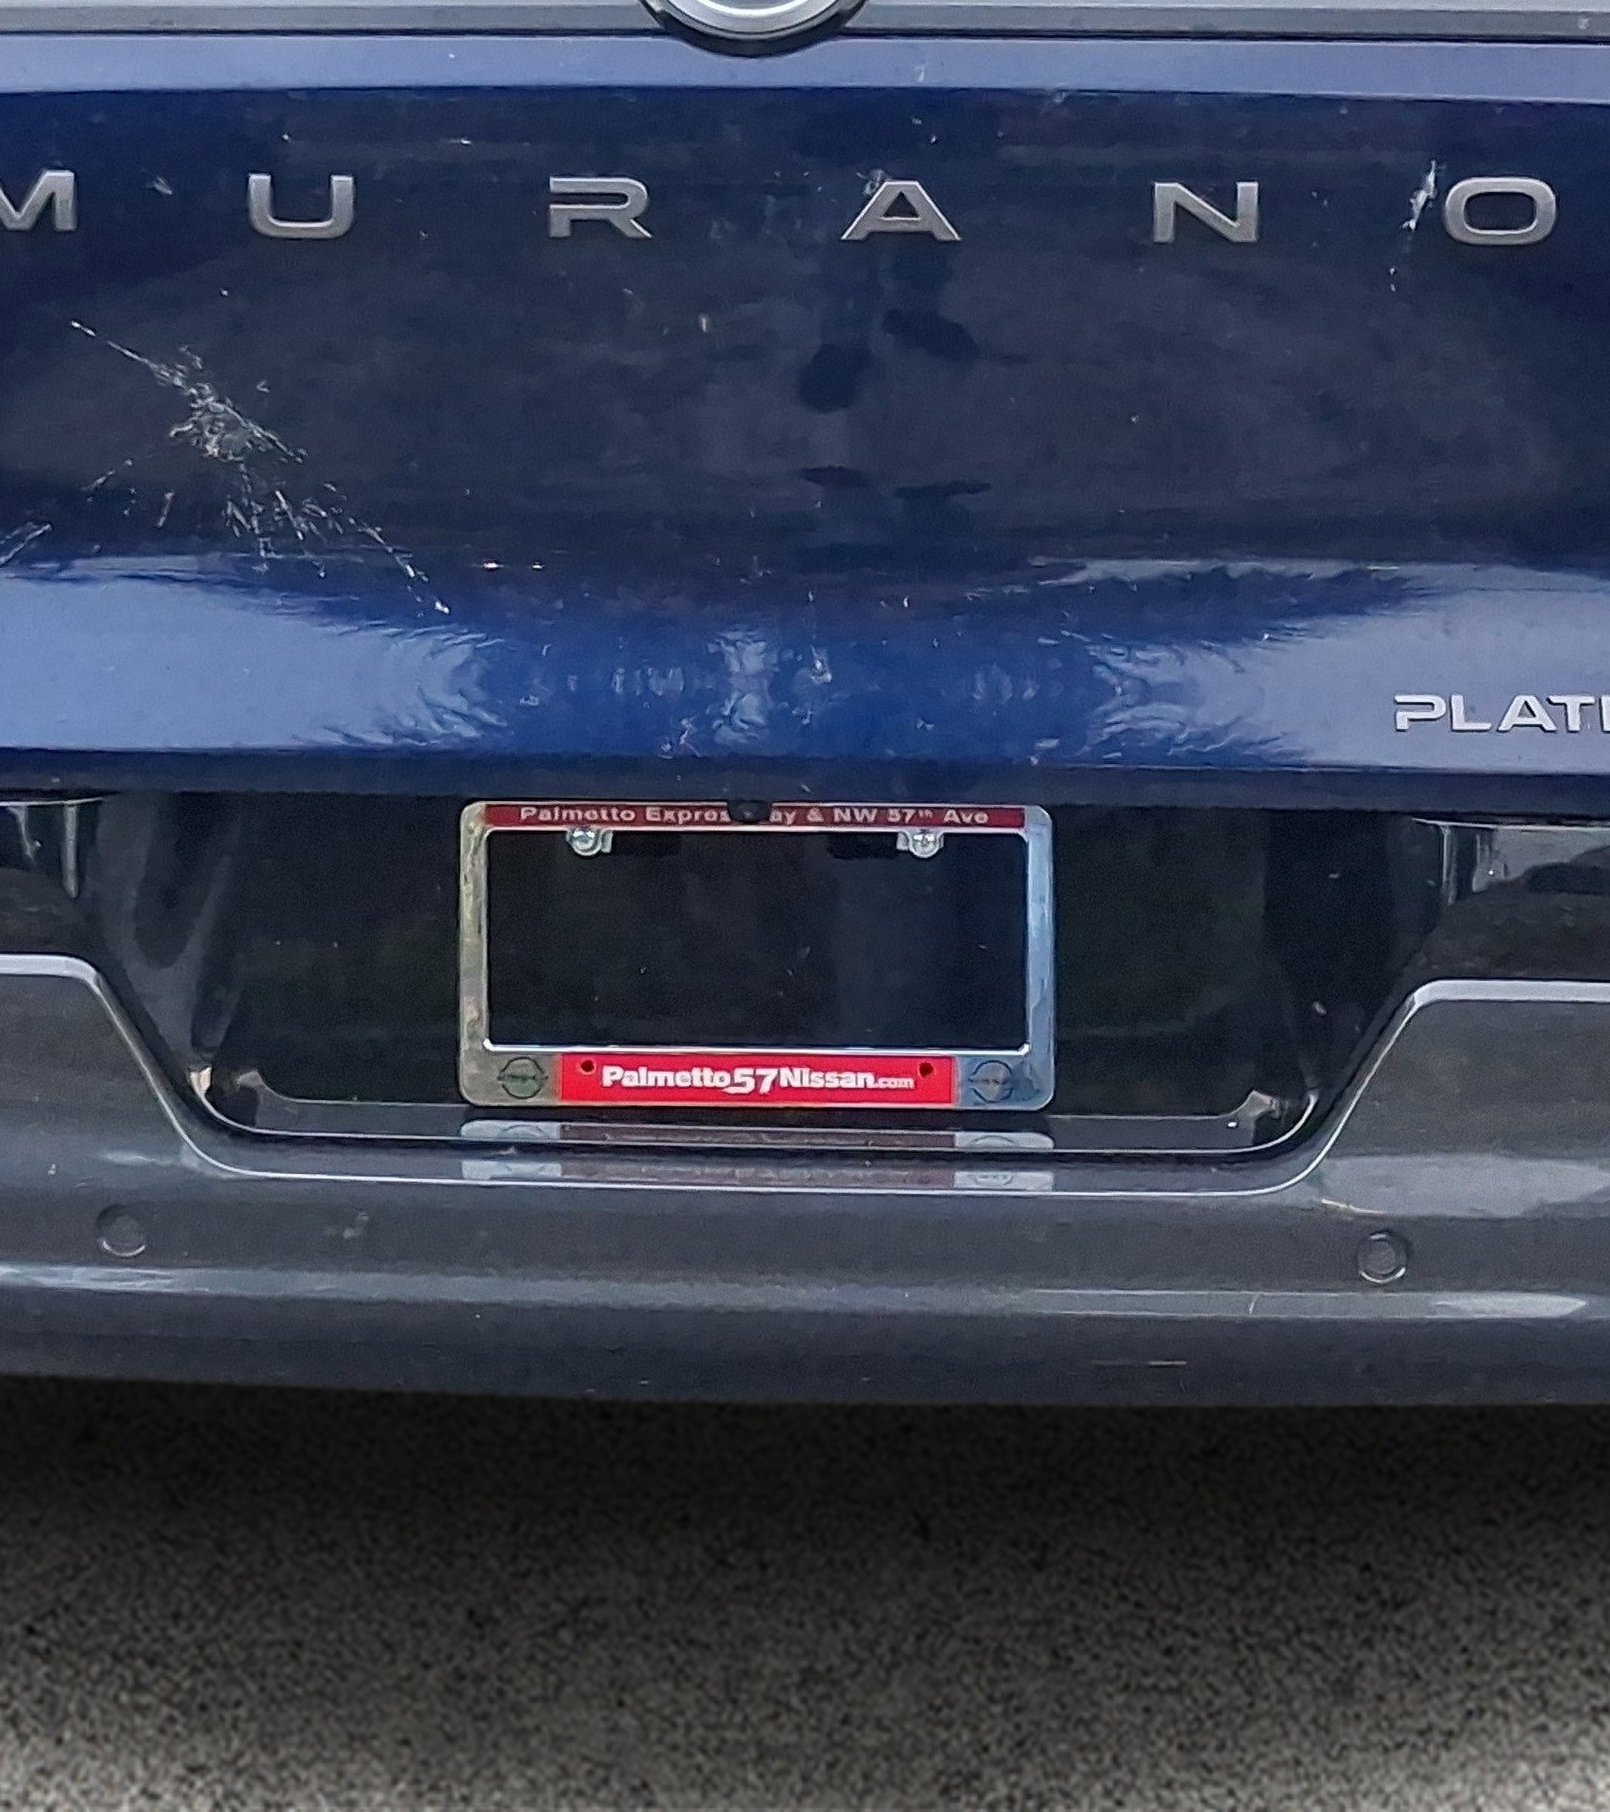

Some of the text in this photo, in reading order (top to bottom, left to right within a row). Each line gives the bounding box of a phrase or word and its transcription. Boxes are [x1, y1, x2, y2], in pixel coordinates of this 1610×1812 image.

[520, 806, 636, 822] Palmetto
[806, 808, 825, 823] &
[833, 808, 877, 823] NW
[887, 809, 934, 824] 57th
[944, 809, 989, 824] Ave
